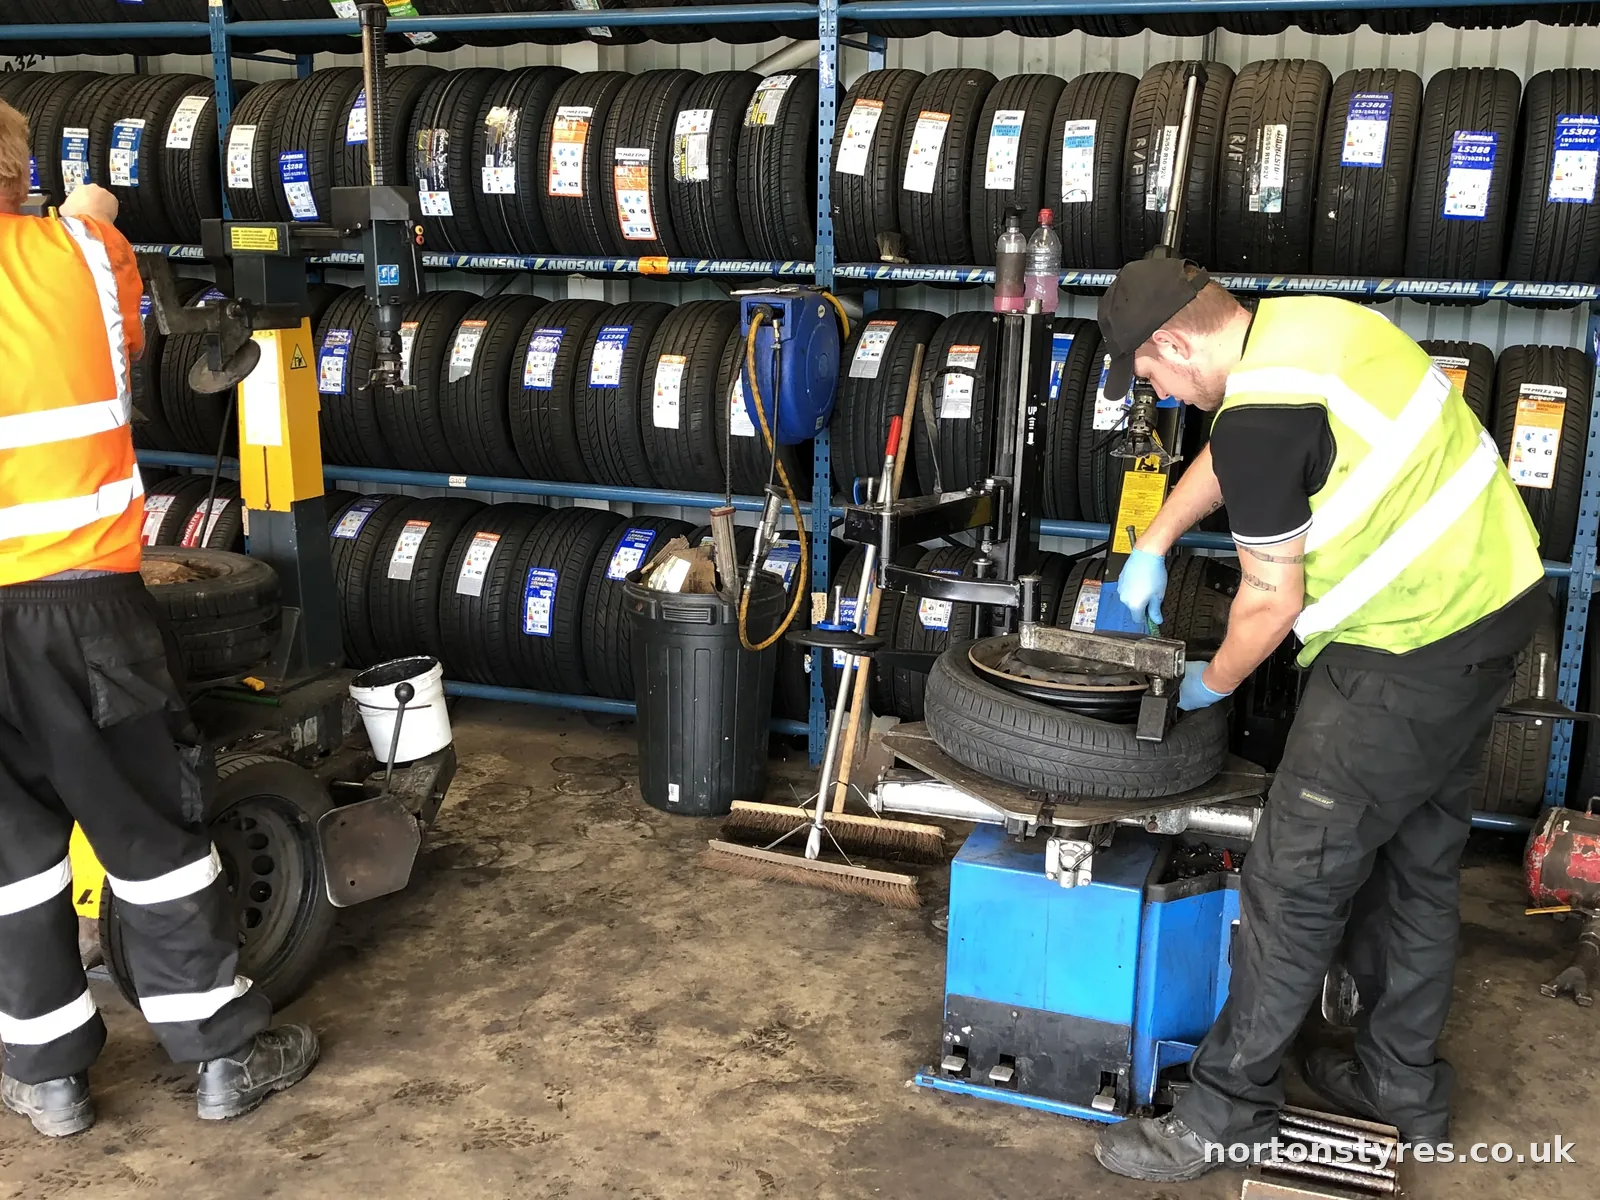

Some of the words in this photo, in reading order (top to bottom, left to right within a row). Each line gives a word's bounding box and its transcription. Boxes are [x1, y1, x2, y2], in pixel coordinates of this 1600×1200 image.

[1562, 129, 1597, 137] LS388
[1457, 145, 1491, 154] LS388
[456, 256, 529, 270] LANDSAIL
[534, 258, 608, 273] LANDSAIL
[694, 260, 773, 274] LANDSAIL
[874, 266, 961, 282] LANDSAIL
[1265, 276, 1368, 293] LANDSAIL
[1374, 279, 1481, 296] LANDSAIL
[1487, 281, 1598, 299] LANDSAIL
[1027, 405, 1038, 416] UP
[182, 512, 202, 547] ANNAITE
